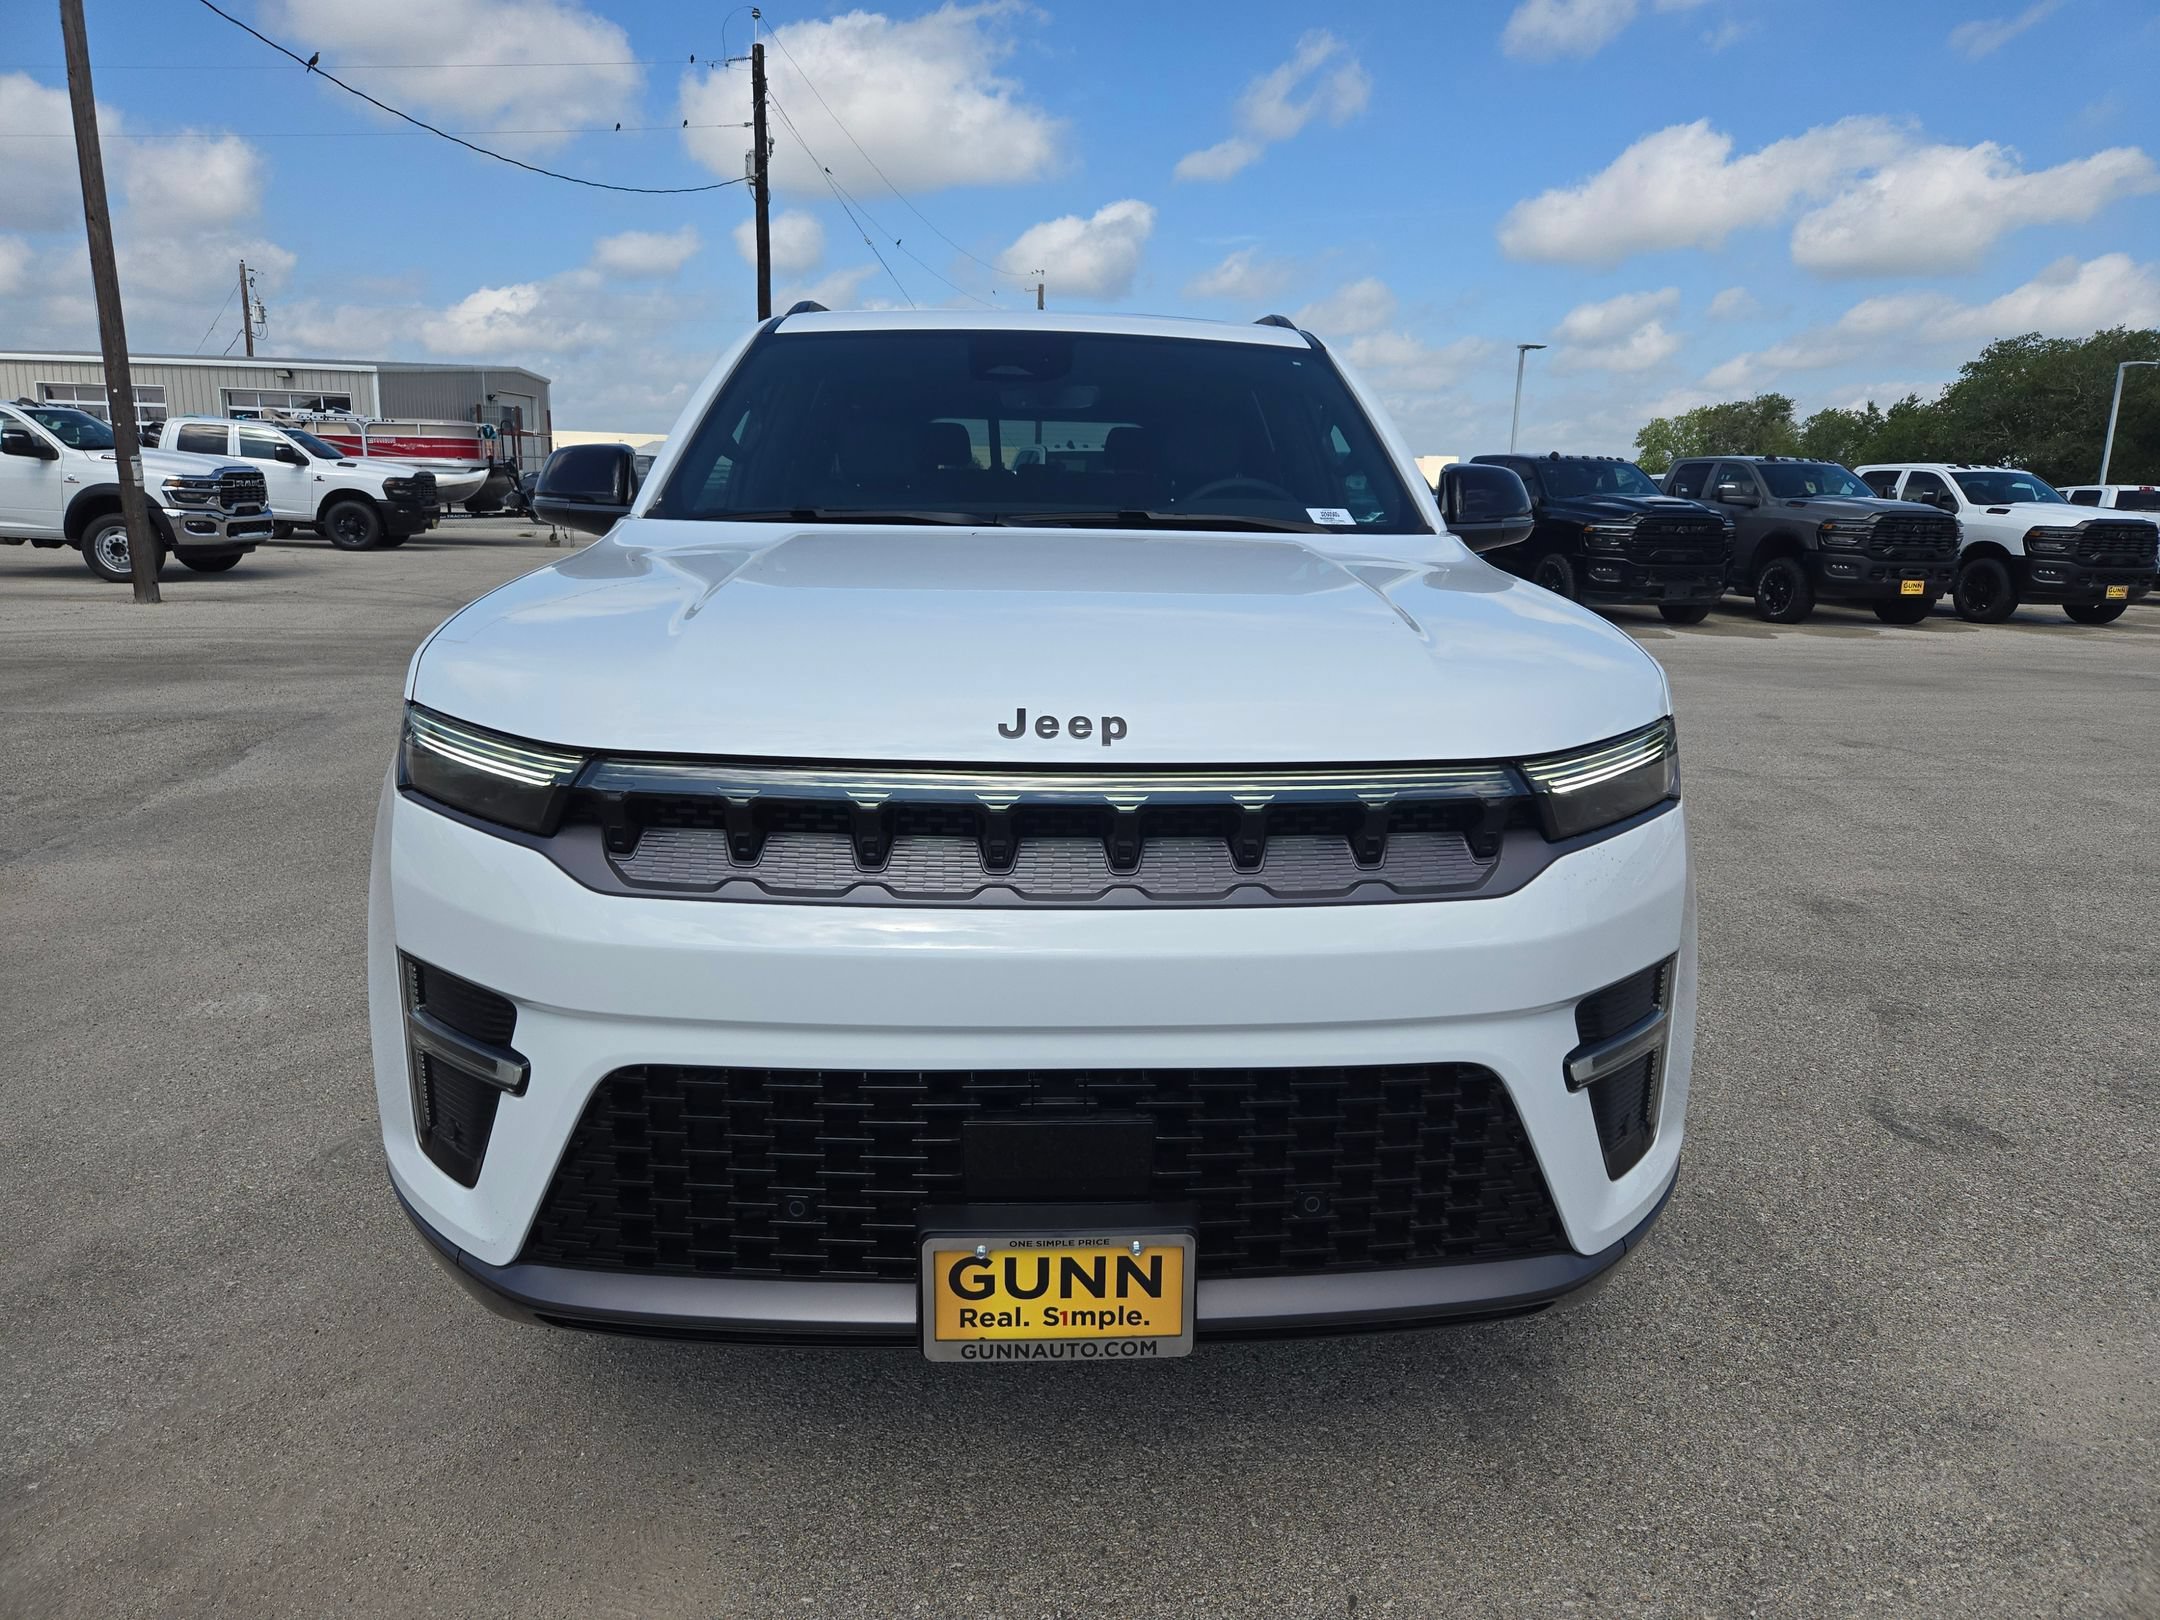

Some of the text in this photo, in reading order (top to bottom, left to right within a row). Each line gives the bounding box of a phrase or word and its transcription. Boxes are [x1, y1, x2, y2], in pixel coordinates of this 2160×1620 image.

[998, 708, 1128, 746] Jeep
[1036, 1239, 1075, 1247] SIMPLE
[1078, 1238, 1110, 1246] PRICE
[948, 1255, 1163, 1301] GUNN
[959, 1307, 1030, 1328] Real.
[960, 1340, 1158, 1360] GUNNAUTO.COM
